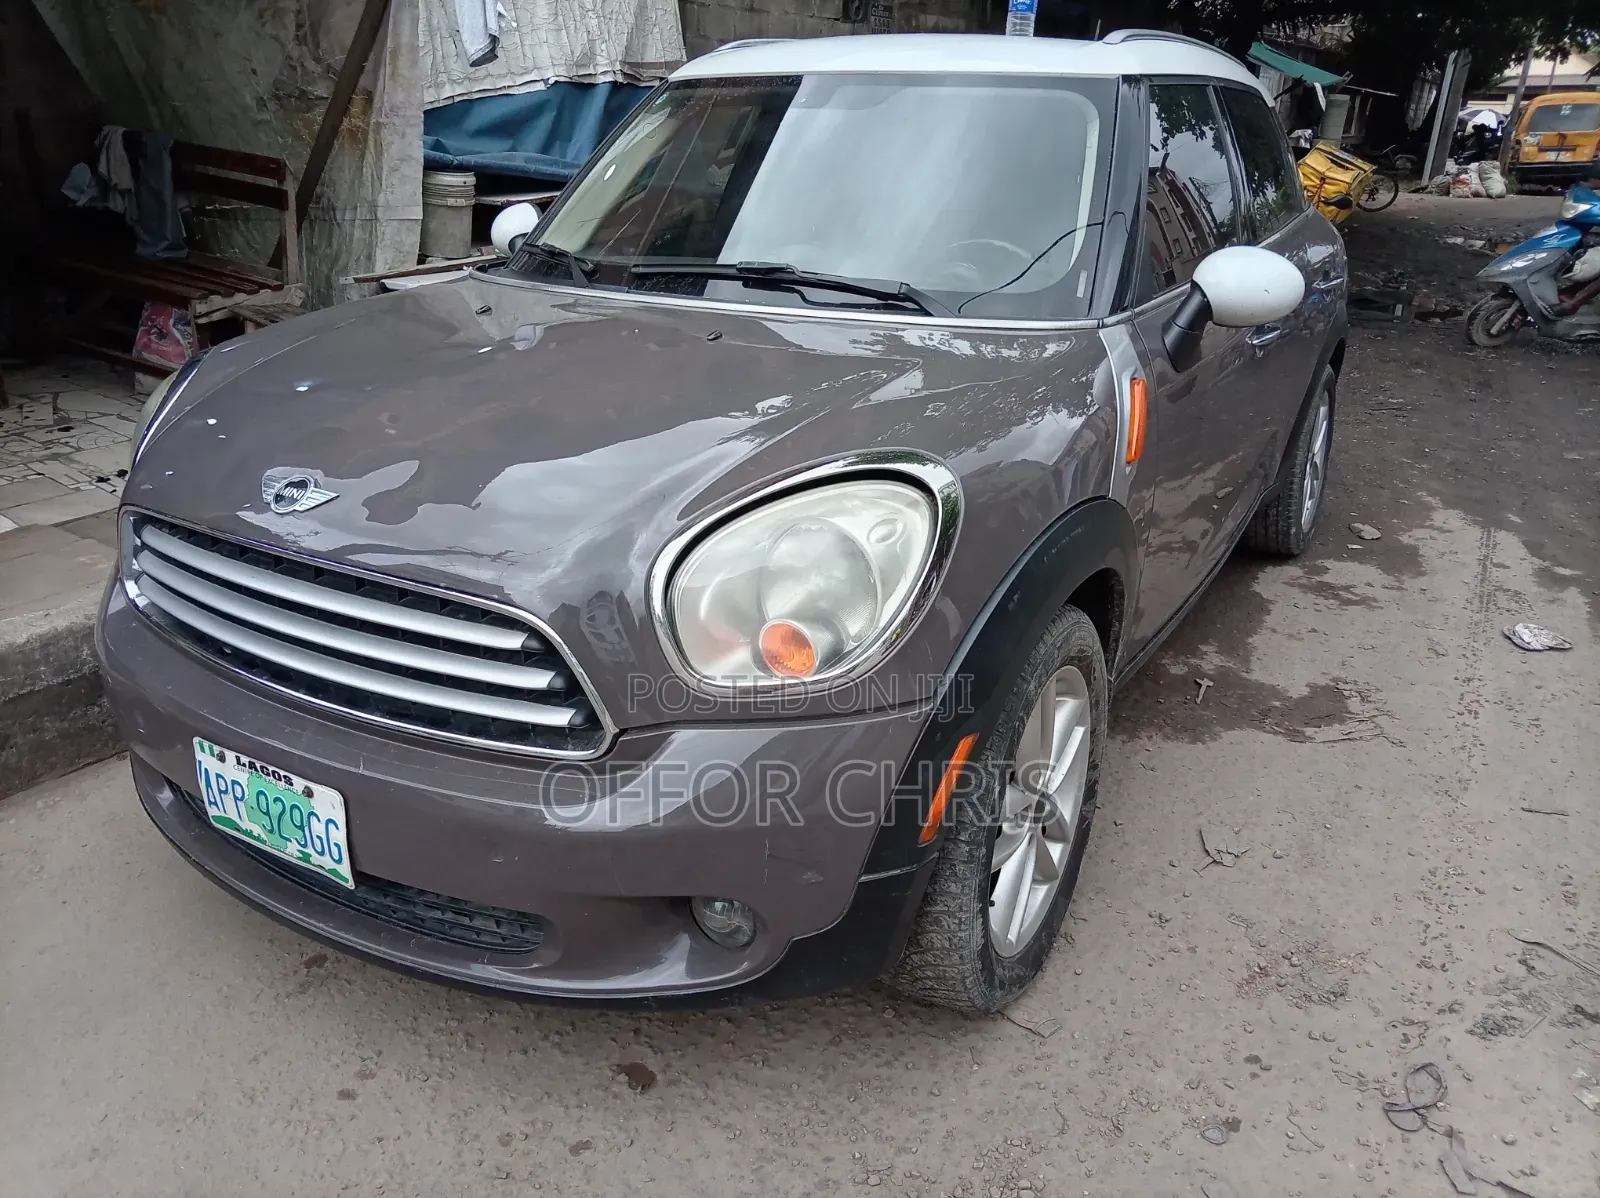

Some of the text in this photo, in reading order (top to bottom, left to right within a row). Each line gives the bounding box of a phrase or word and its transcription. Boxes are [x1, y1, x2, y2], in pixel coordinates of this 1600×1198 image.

[277, 486, 306, 500] MINI
[235, 755, 294, 787] LAGOS
[255, 788, 345, 865] 929GG
